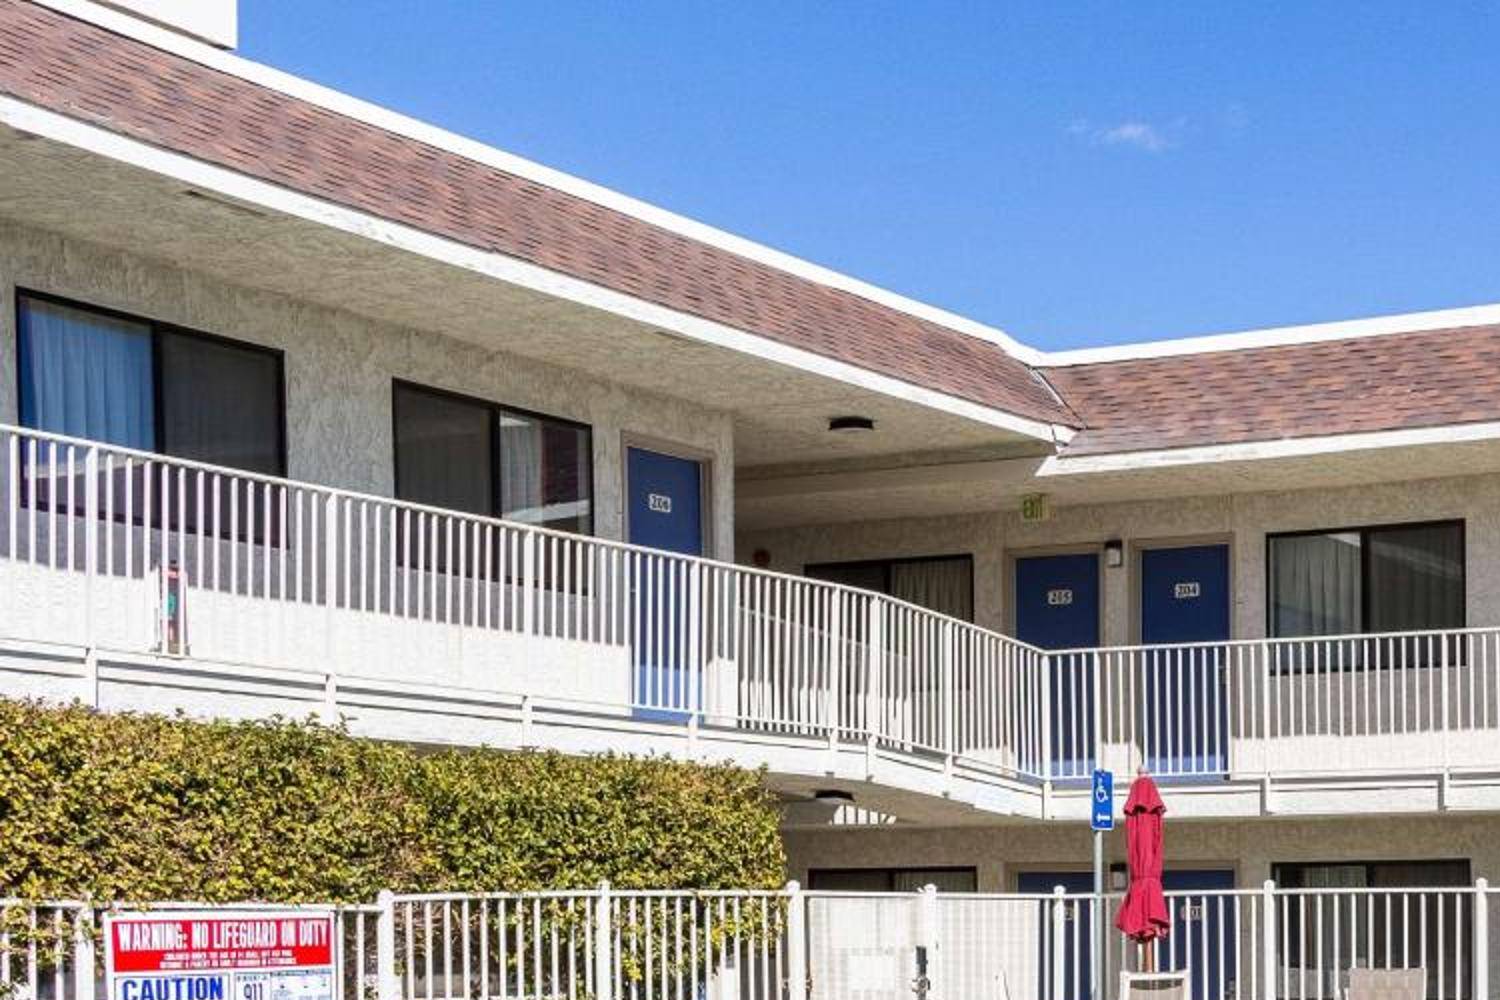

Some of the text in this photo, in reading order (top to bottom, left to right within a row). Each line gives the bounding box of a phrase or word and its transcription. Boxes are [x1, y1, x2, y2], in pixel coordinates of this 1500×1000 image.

[117, 918, 328, 951] WARNING: NO LIFEGUARD ON DUTY
